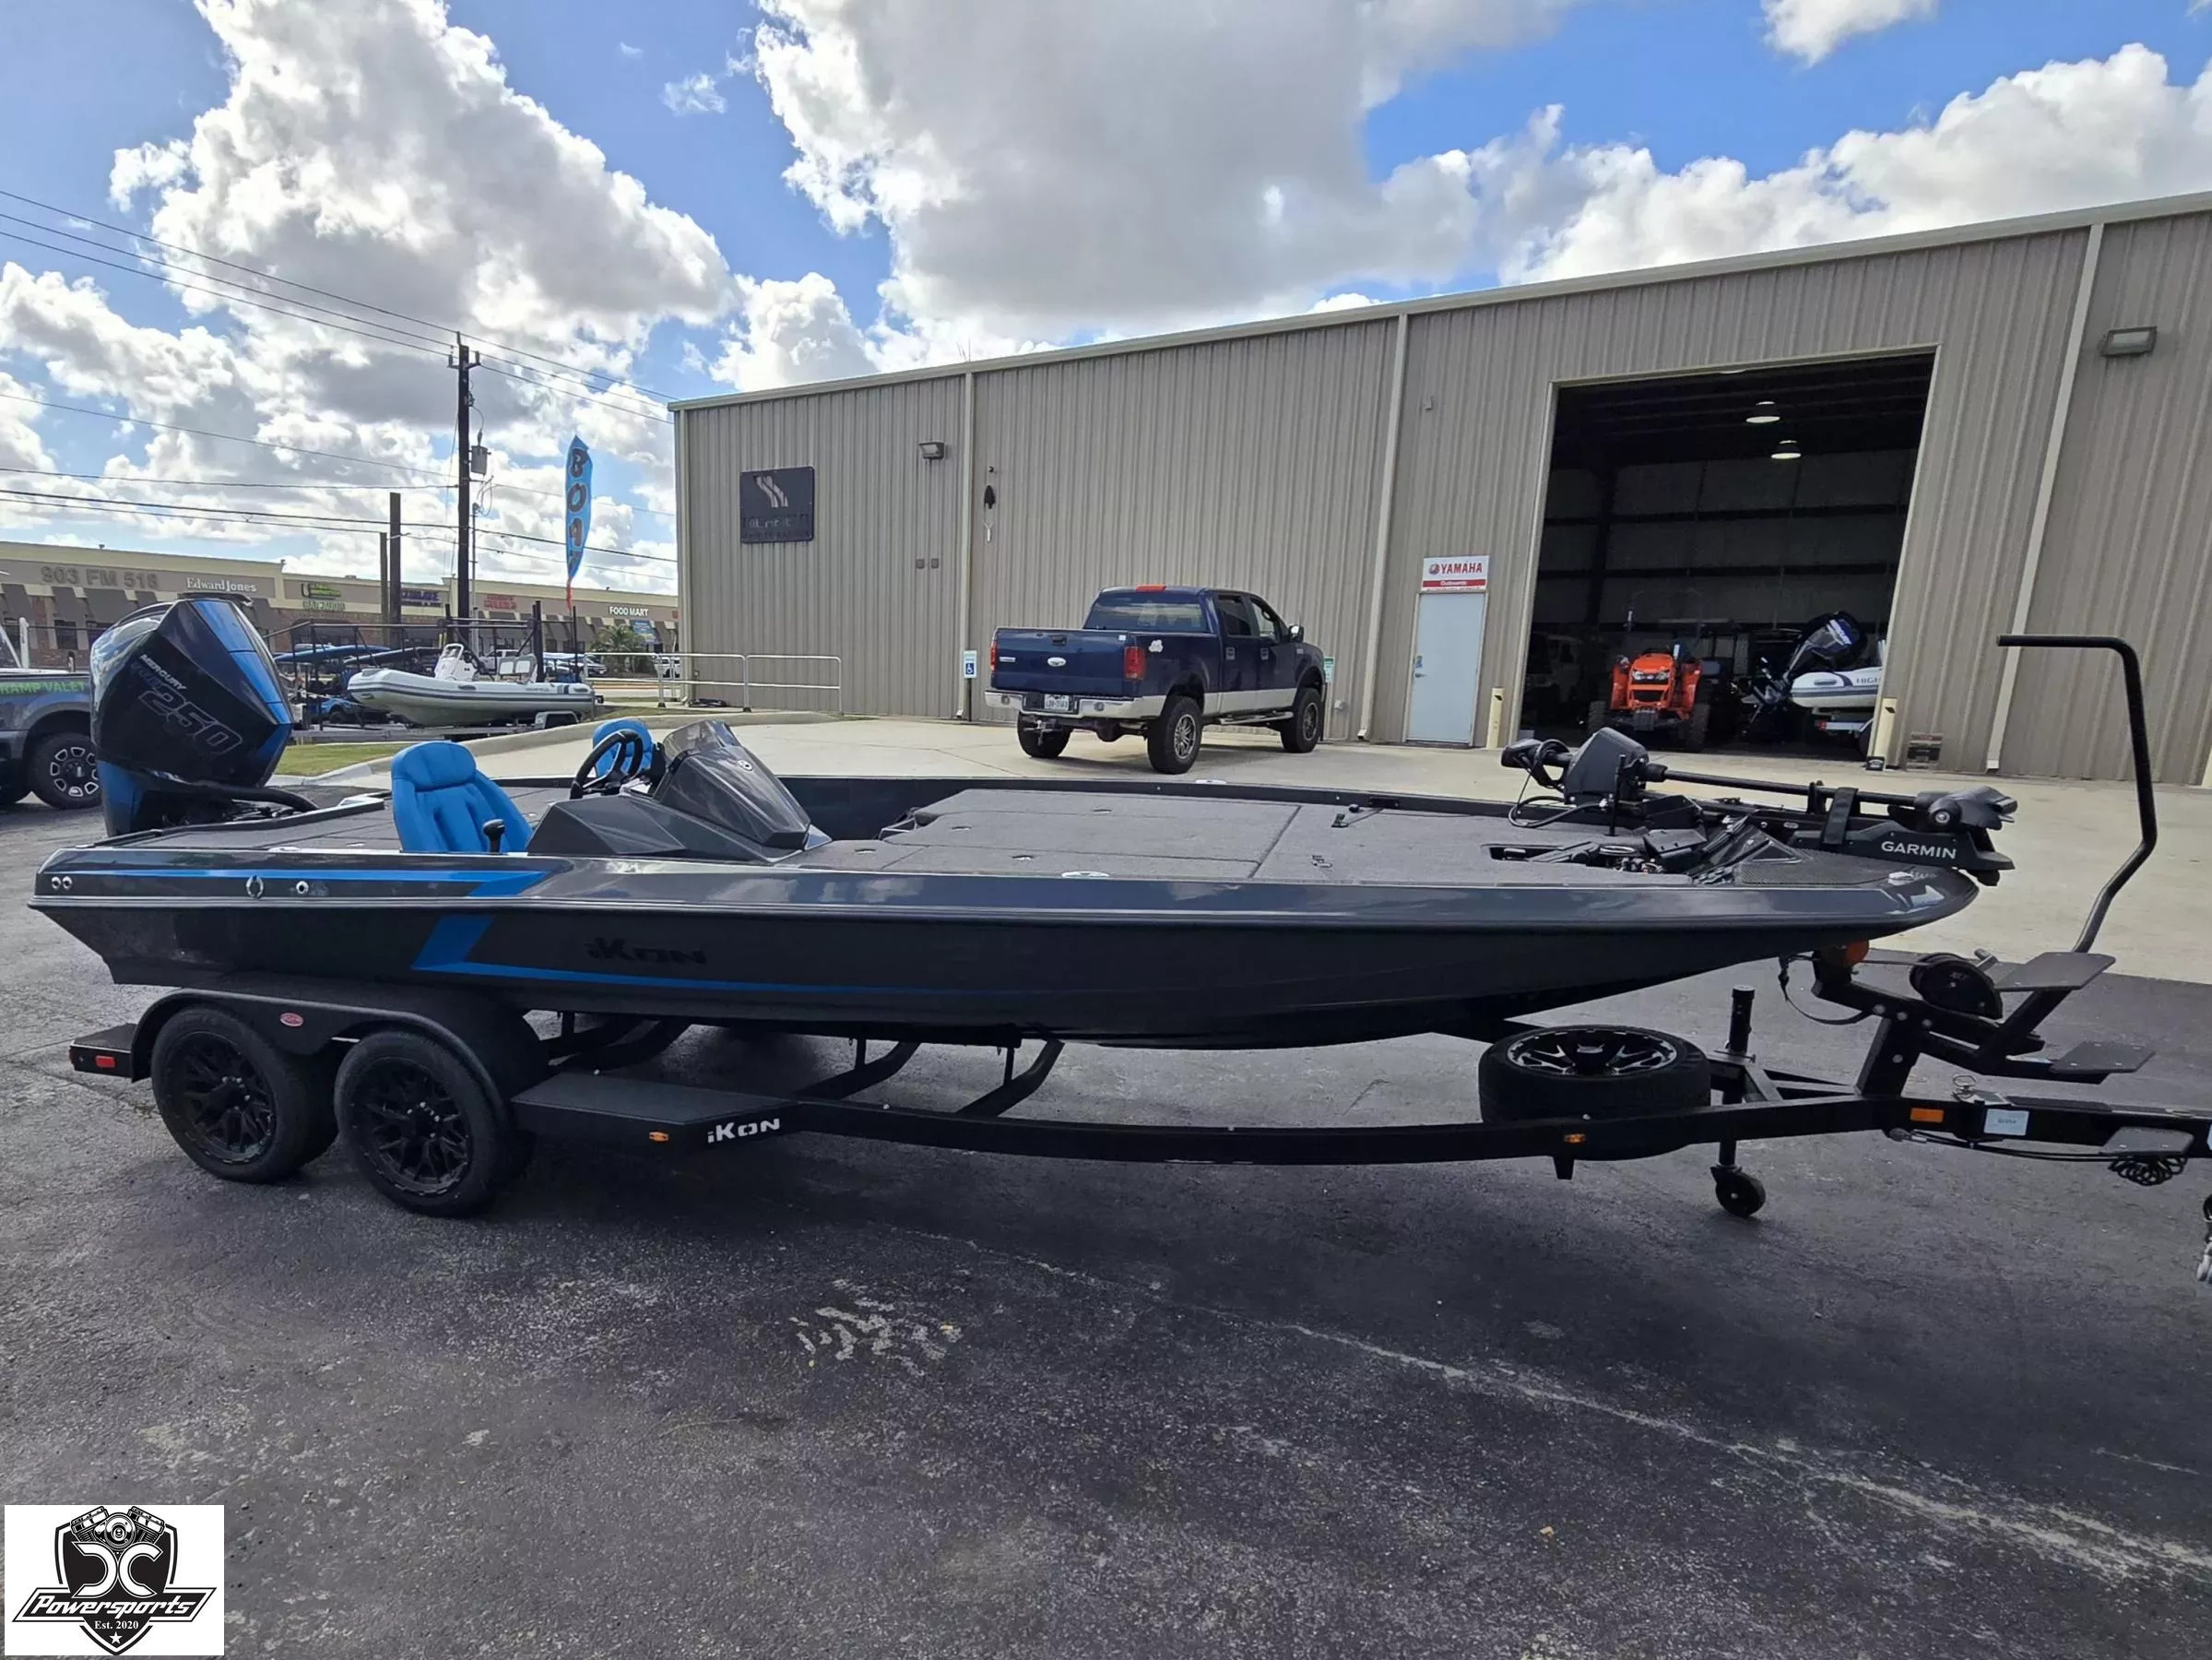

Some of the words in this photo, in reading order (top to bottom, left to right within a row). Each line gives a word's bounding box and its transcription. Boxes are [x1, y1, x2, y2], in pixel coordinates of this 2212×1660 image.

[86, 568, 118, 587] FM
[1441, 563, 1483, 574] YAMAHA
[609, 606, 628, 616] FOOD
[629, 608, 649, 617] MART
[140, 653, 187, 690] MERCURY
[138, 682, 243, 755] 250
[1881, 840, 1957, 860] GARMIN
